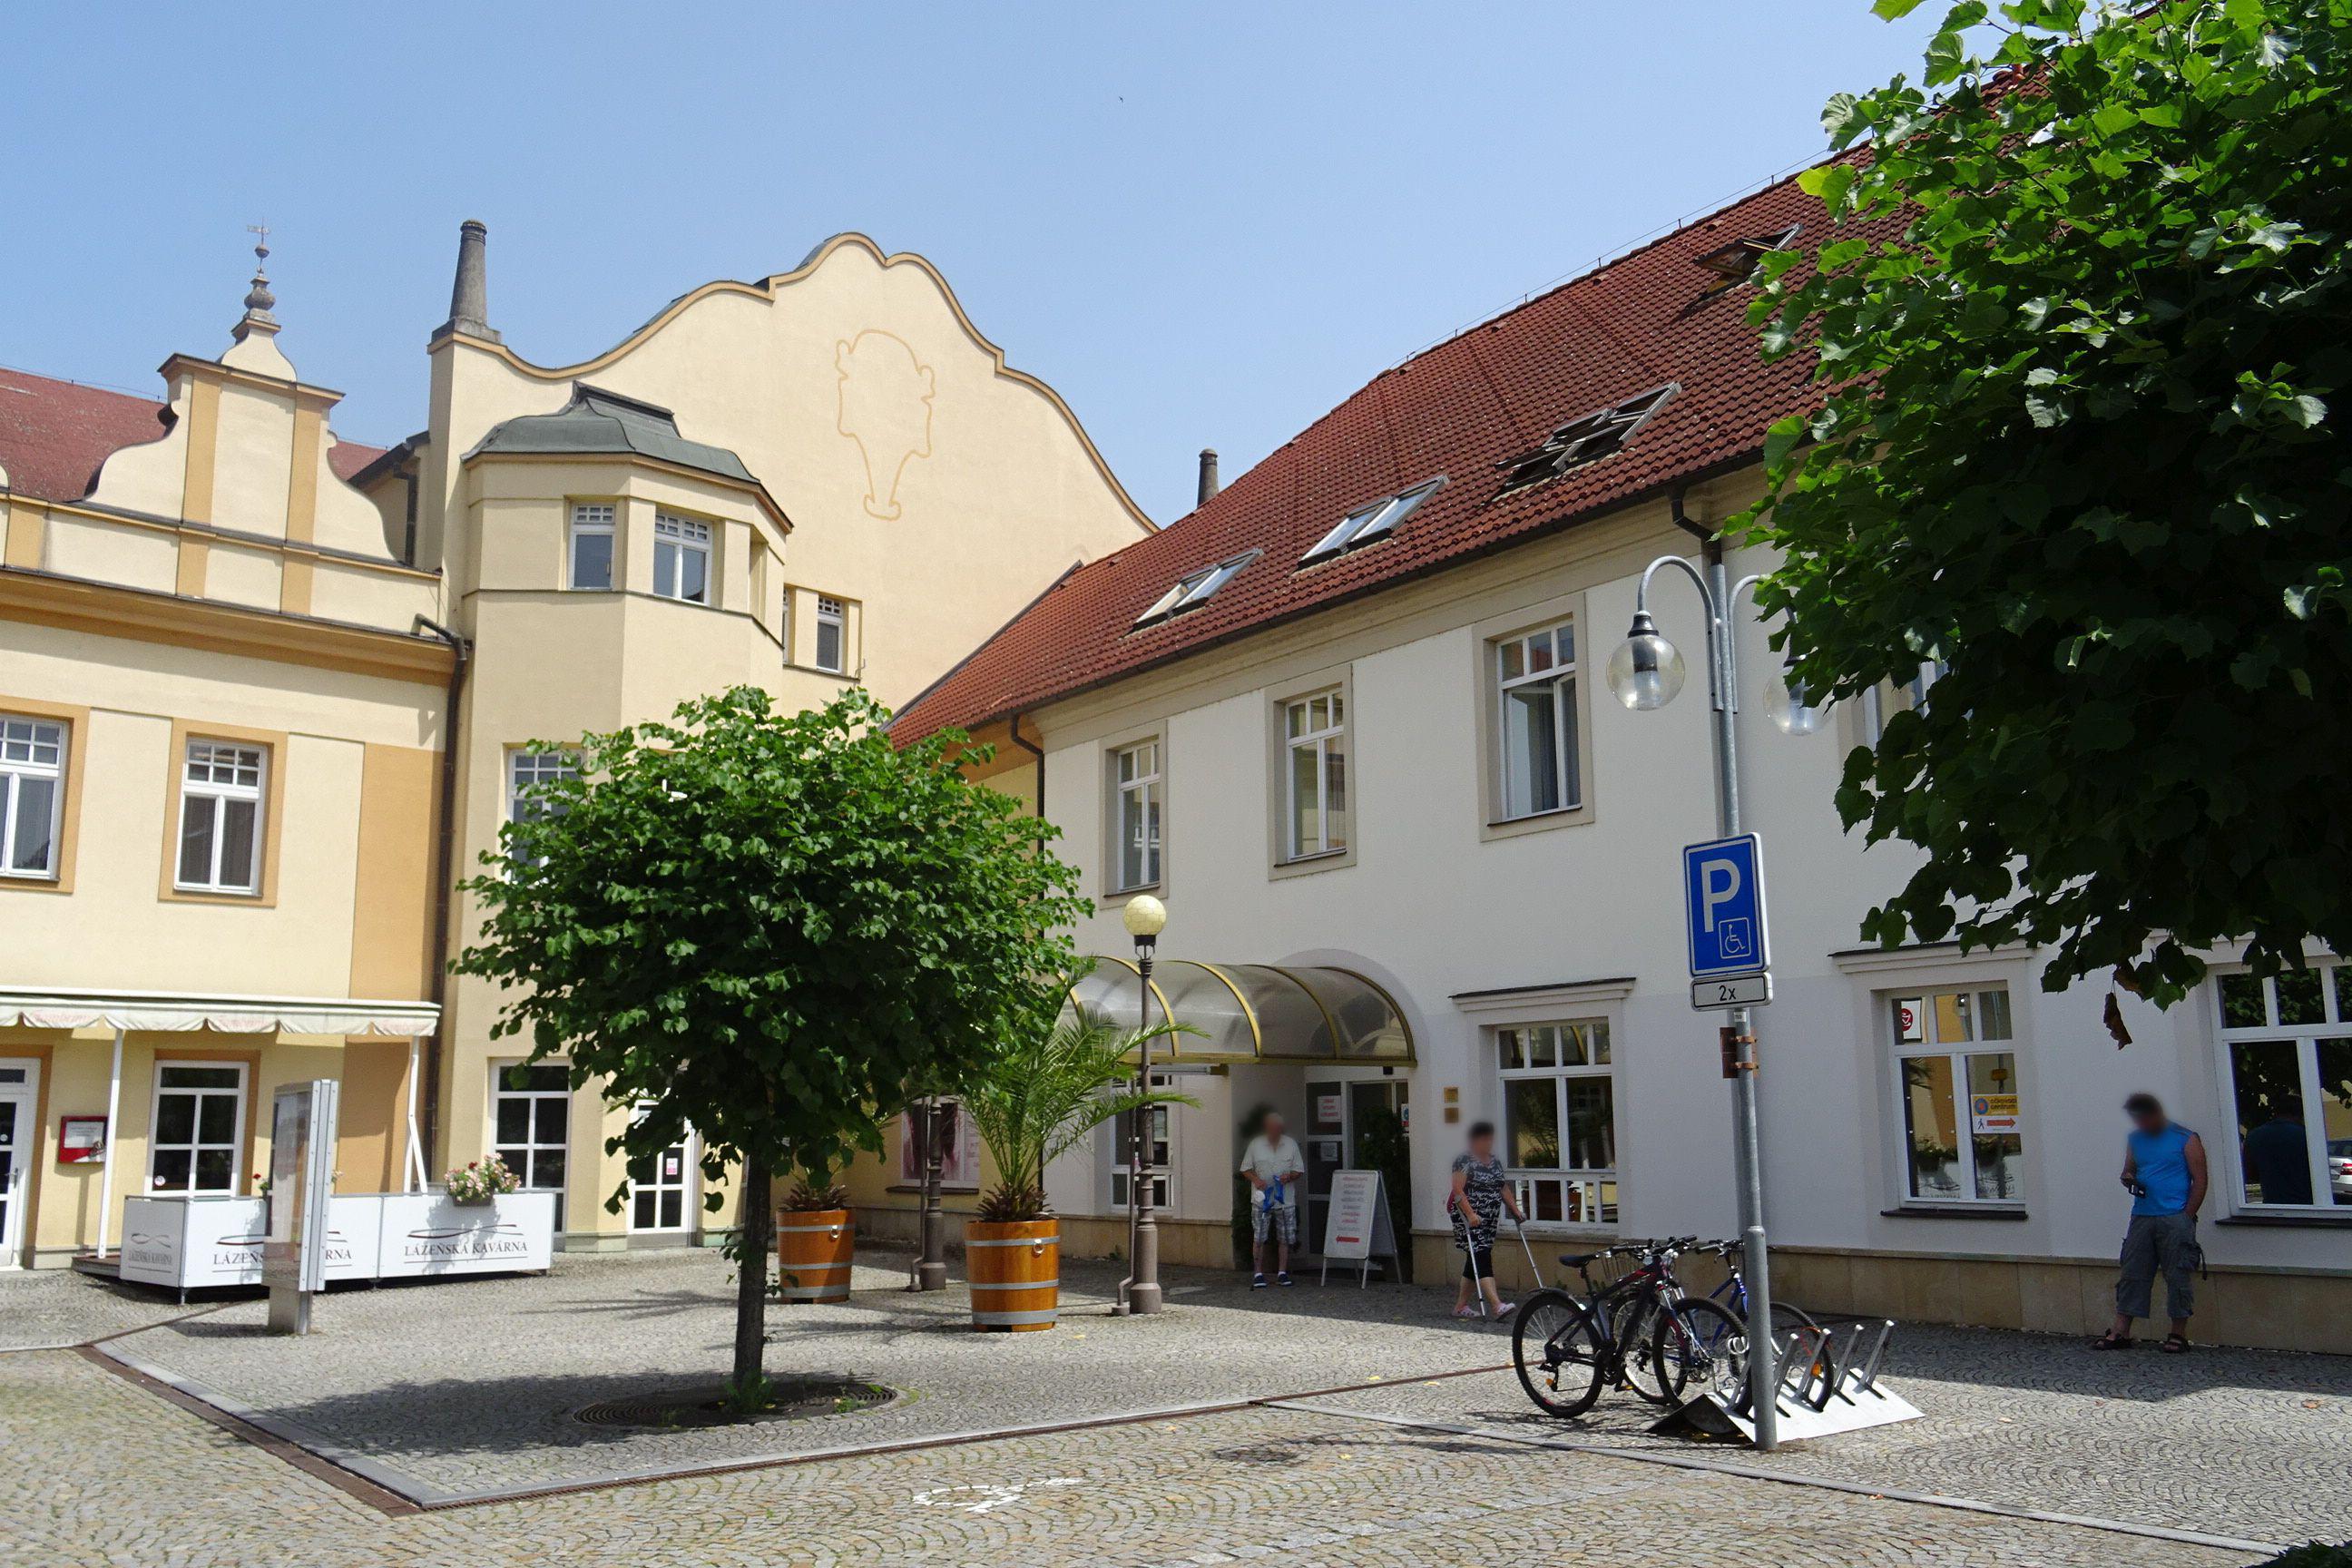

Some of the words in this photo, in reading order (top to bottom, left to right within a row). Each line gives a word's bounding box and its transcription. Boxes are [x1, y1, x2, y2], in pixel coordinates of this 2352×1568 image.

[1700, 858, 1741, 934] P
[1718, 985, 1737, 1002] 2x
[404, 1243, 469, 1257] LÁZEŇSKÁ
[472, 1240, 528, 1254] KAVÁRNA
[213, 1250, 264, 1265] LÁZEŇS
